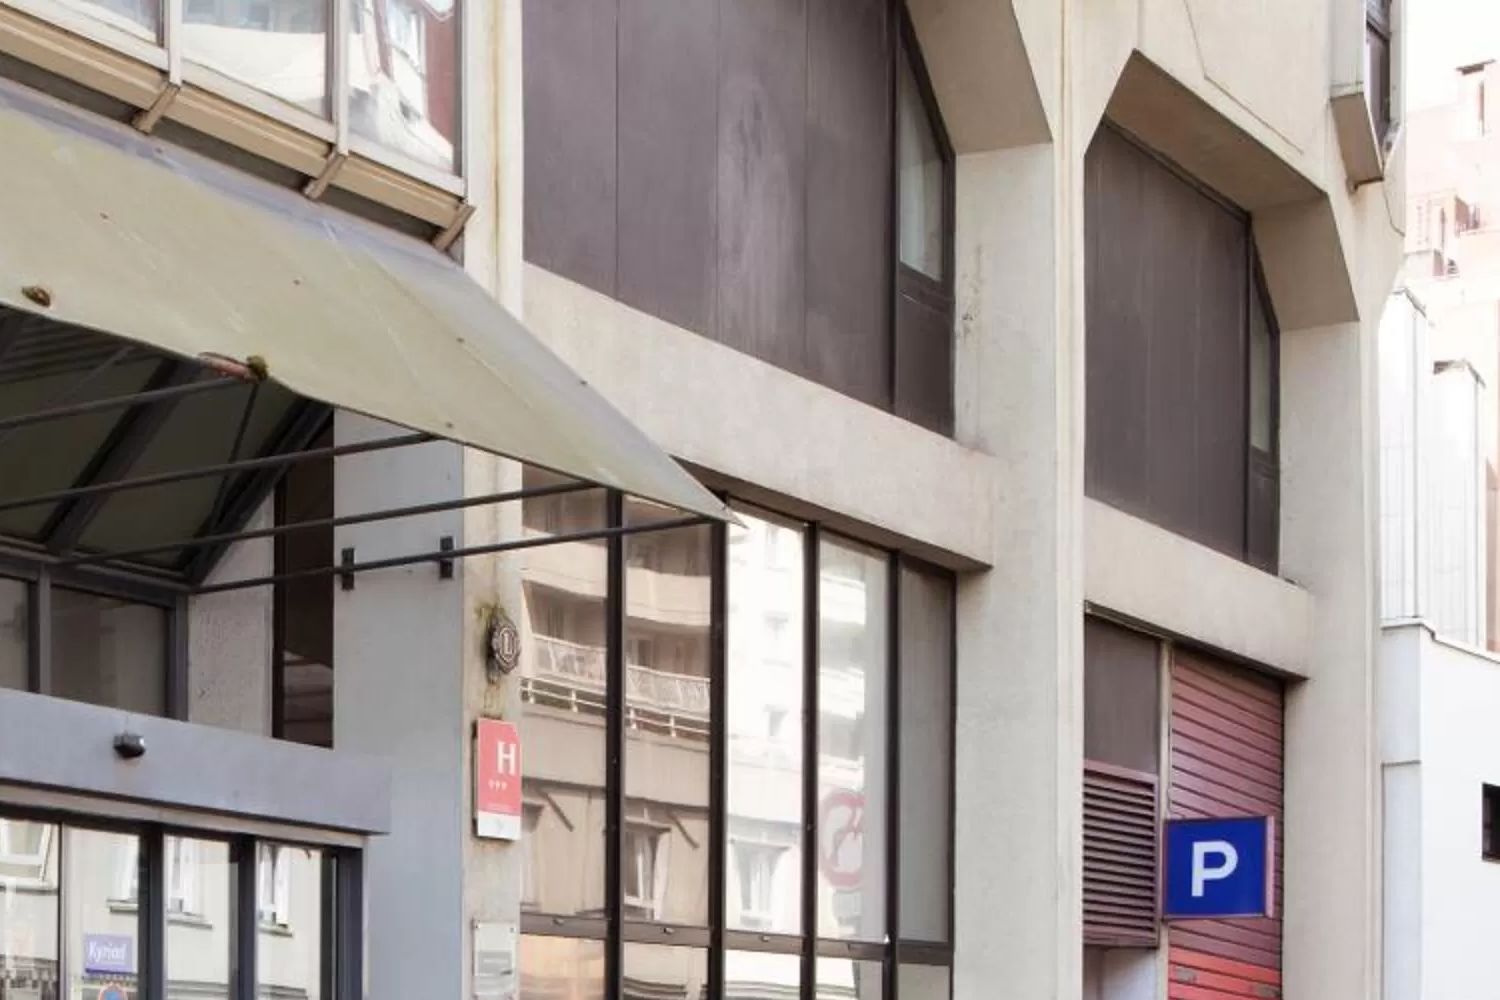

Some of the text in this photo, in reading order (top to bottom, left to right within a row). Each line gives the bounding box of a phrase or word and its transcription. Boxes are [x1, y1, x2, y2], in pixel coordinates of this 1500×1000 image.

[496, 741, 517, 777] H
[1190, 839, 1239, 898] P
[88, 939, 128, 964] Kyriad
